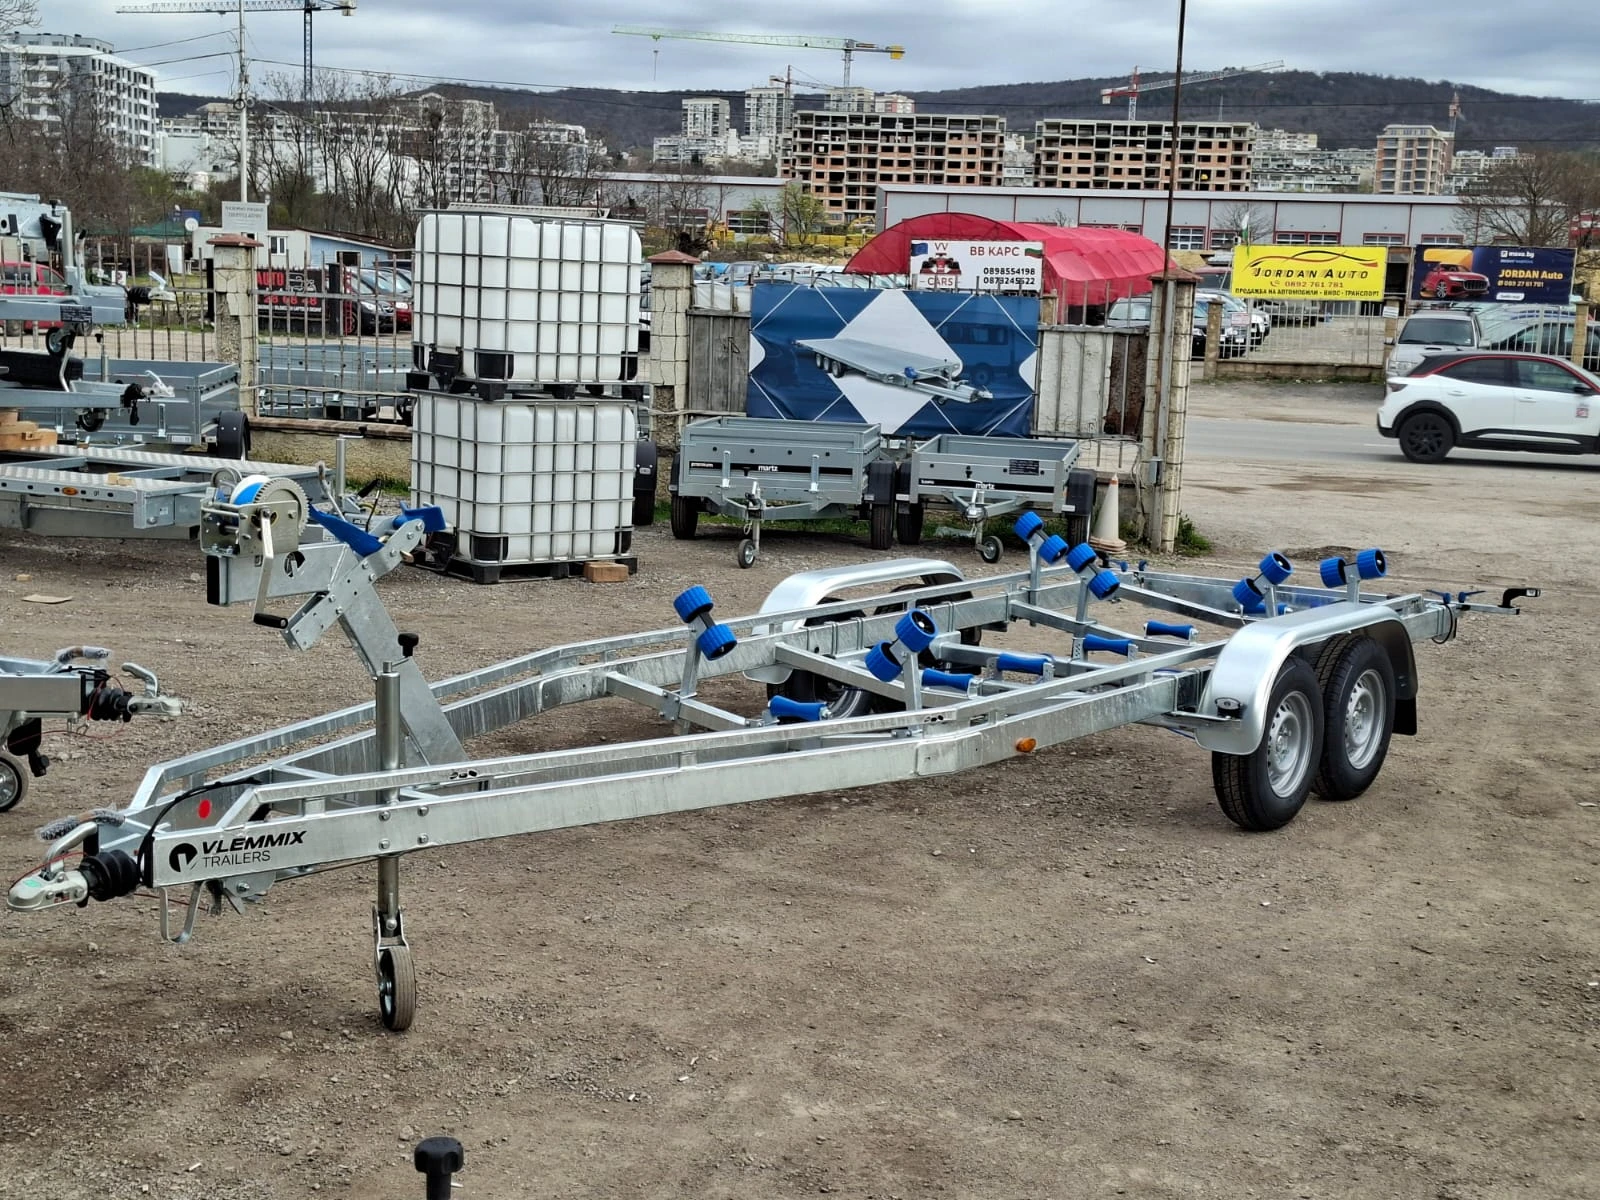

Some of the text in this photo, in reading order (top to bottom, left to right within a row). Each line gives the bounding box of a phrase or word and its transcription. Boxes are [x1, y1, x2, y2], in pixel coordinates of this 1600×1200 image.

[989, 246, 1020, 257] КАРС
[983, 267, 1036, 275] 0898554198
[1253, 267, 1369, 279] JORDAN AUTO
[1499, 269, 1563, 280] JORDAN Auto
[927, 277, 953, 286] CARS
[202, 831, 307, 854] VLEMMIX
[202, 850, 271, 868] TRAILERS
